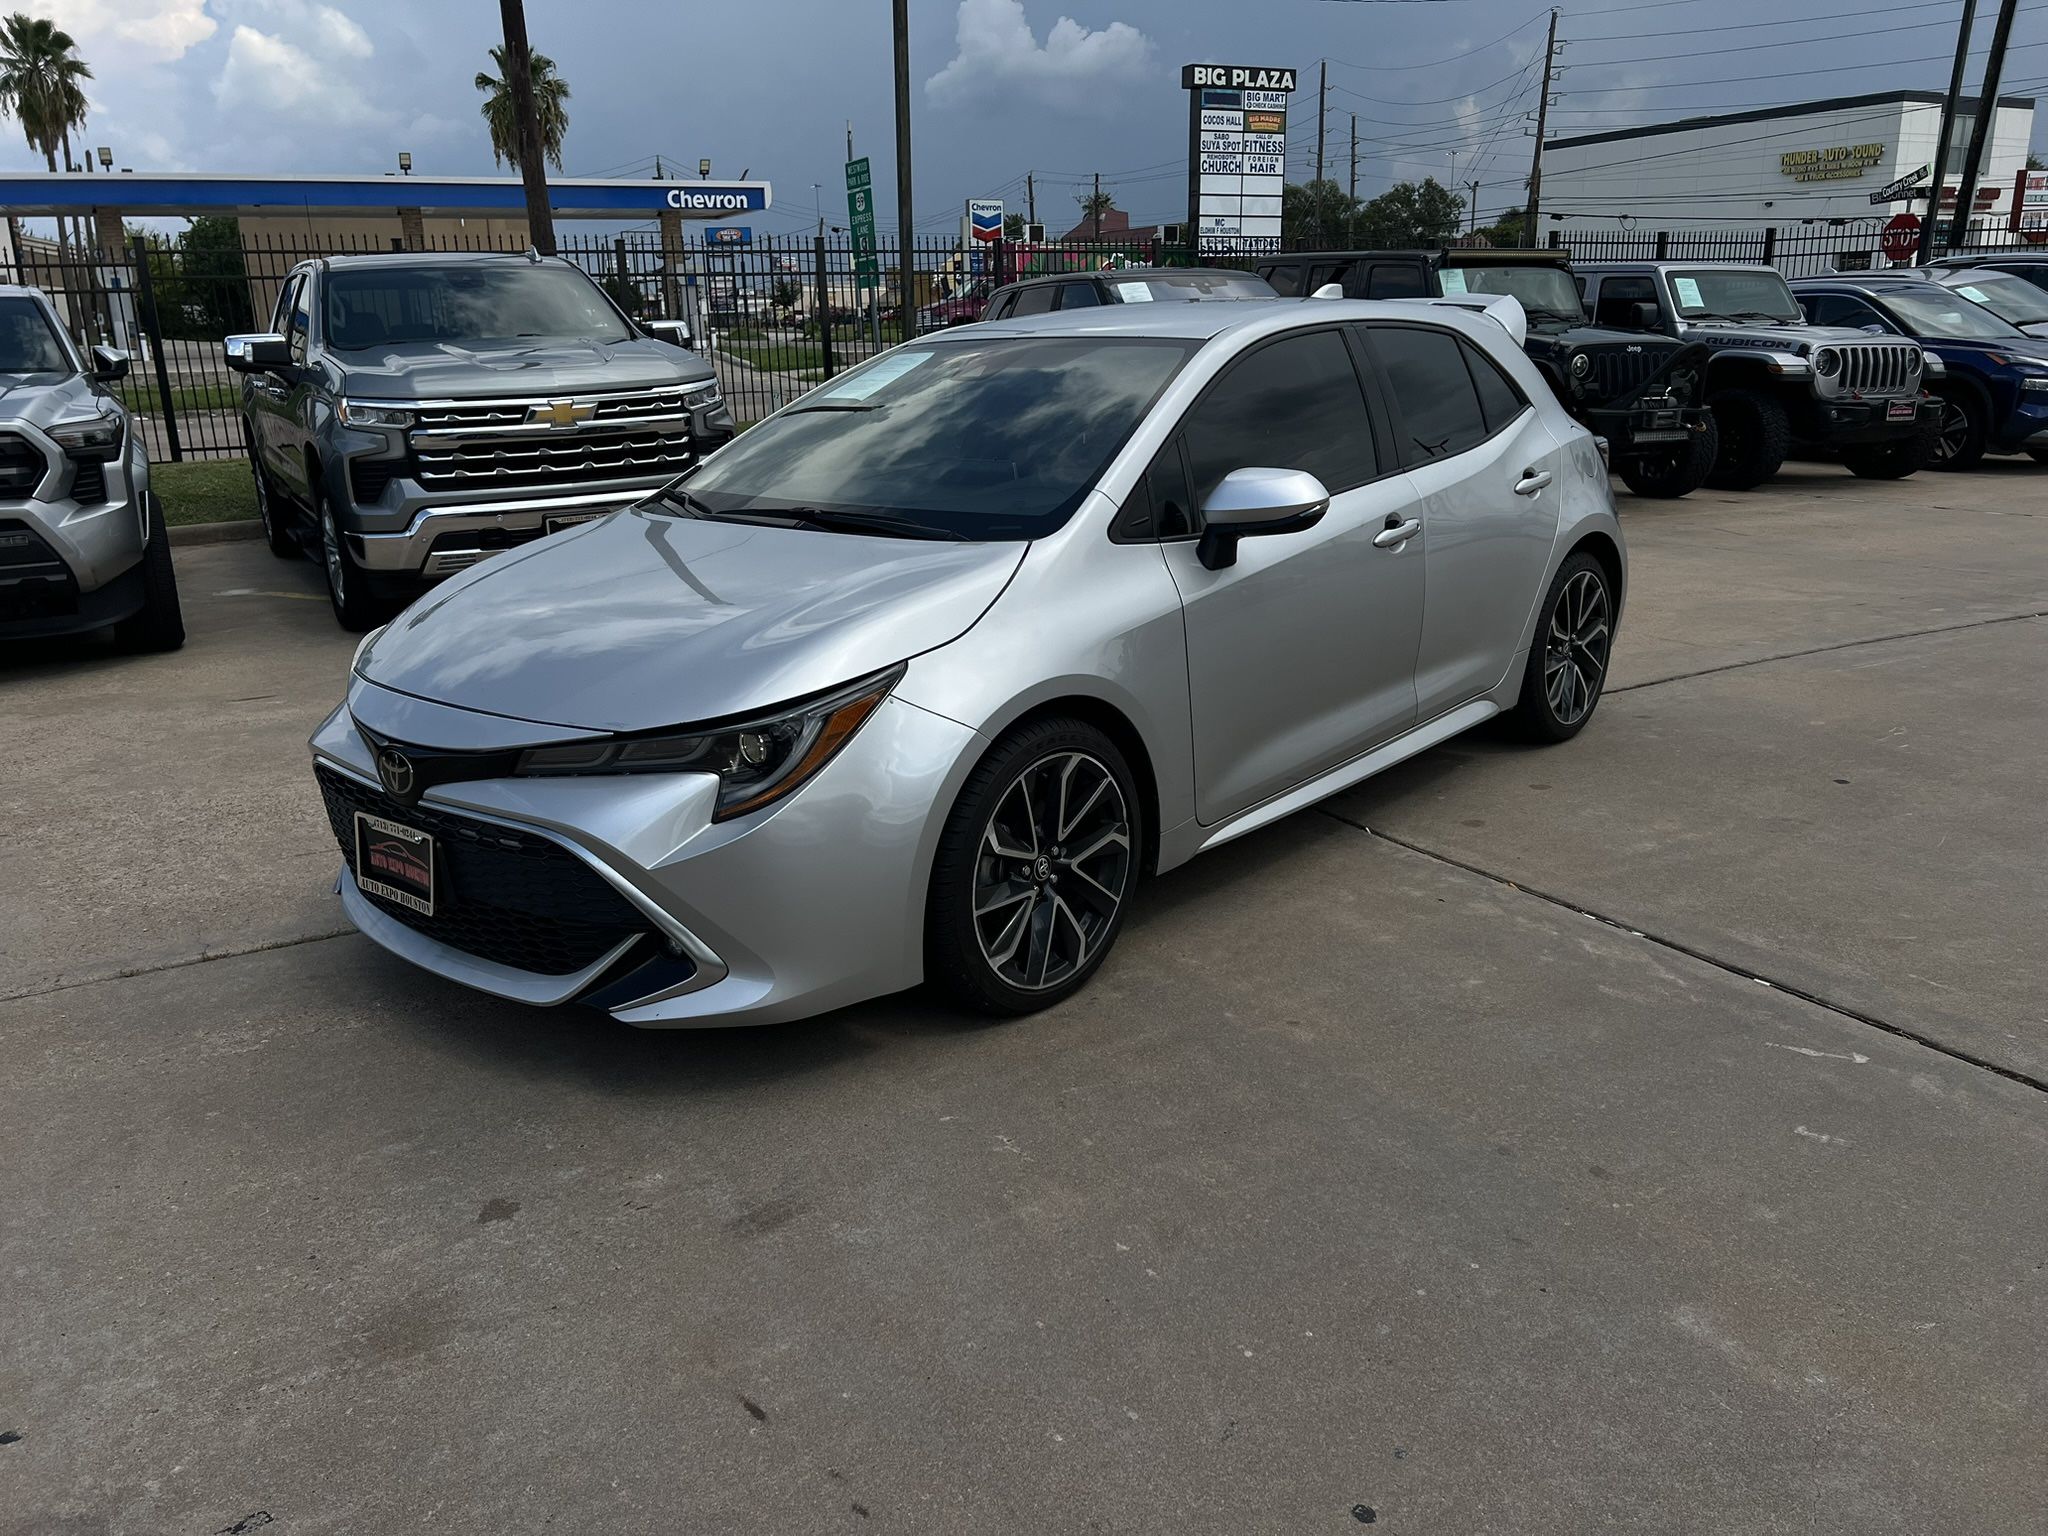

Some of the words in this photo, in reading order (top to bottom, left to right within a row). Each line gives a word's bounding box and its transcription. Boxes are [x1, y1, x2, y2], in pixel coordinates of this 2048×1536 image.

[1194, 67, 1226, 86] BIG
[1232, 69, 1294, 89] PLAZA
[1246, 92, 1261, 102] BIG
[1262, 93, 1285, 103] MART
[1203, 115, 1225, 125] COCOS
[1225, 116, 1242, 126] HALL
[1260, 115, 1281, 124] MADRE
[1201, 140, 1220, 151] SUYA
[1221, 141, 1241, 151] SPOT
[1244, 140, 1284, 153] FITNESS
[1823, 147, 1847, 161] AUTO
[1851, 144, 1882, 158] SOUND
[1201, 160, 1242, 173] CHURCH
[1249, 164, 1277, 173] HAIR
[1882, 180, 1903, 197] Country
[1902, 173, 1919, 187] Creek
[667, 190, 748, 209] Chevron
[971, 203, 1002, 211] Chevron
[852, 213, 872, 225] EXPRESS
[1884, 228, 1920, 247] STOP
[1626, 345, 1642, 353] Jeep
[1705, 336, 1792, 349] RUBICON
[361, 878, 379, 893] AUTO
[381, 884, 399, 901] EXPO
[400, 893, 431, 914] HOUSTON
